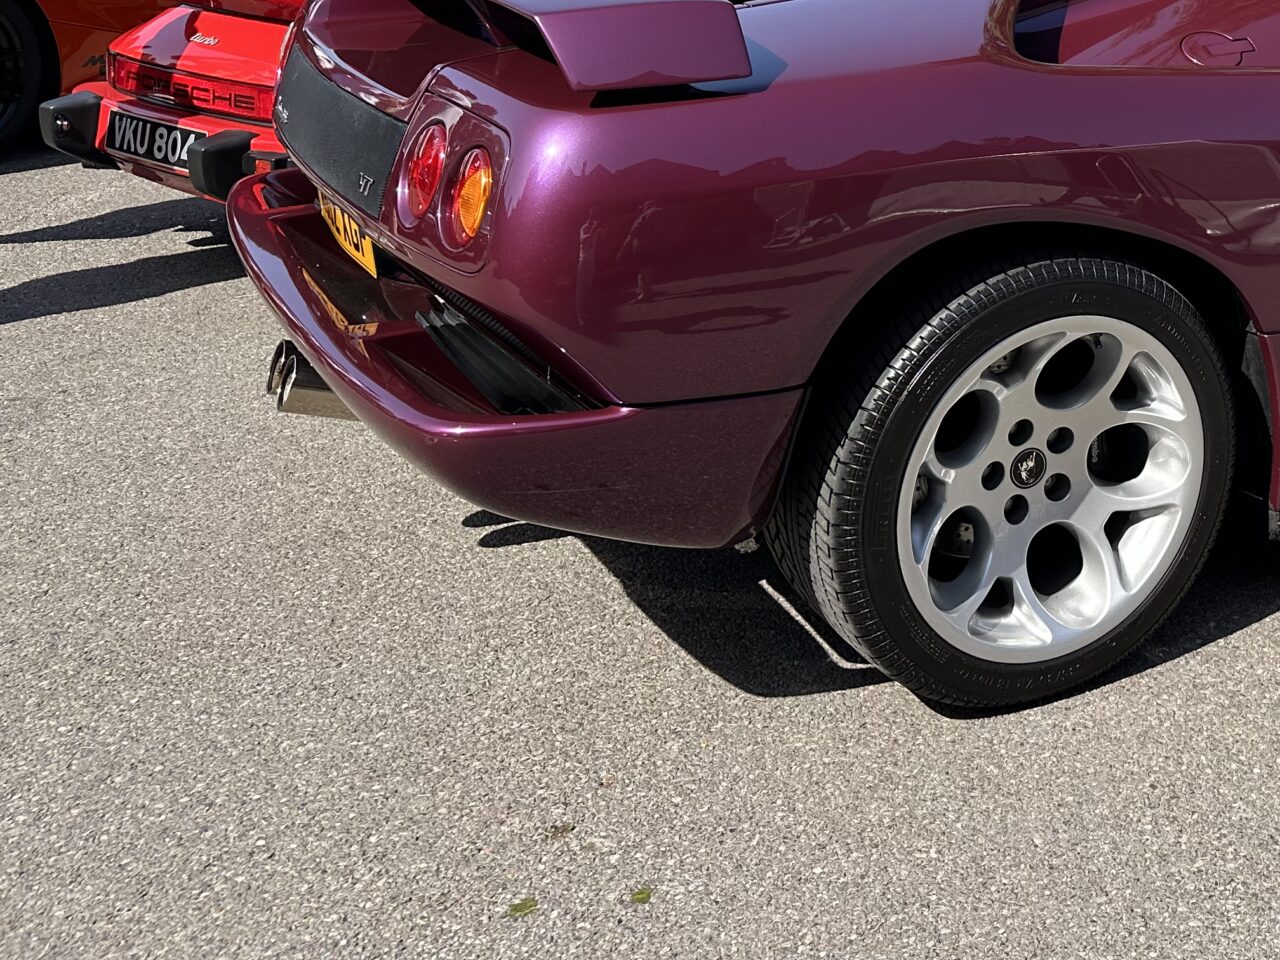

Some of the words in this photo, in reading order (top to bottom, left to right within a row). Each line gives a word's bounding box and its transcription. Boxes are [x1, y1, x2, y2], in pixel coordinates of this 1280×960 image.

[190, 32, 219, 45] turbo
[127, 71, 255, 111] PORSCHE
[114, 115, 151, 155] VKU
[360, 172, 373, 196] VT
